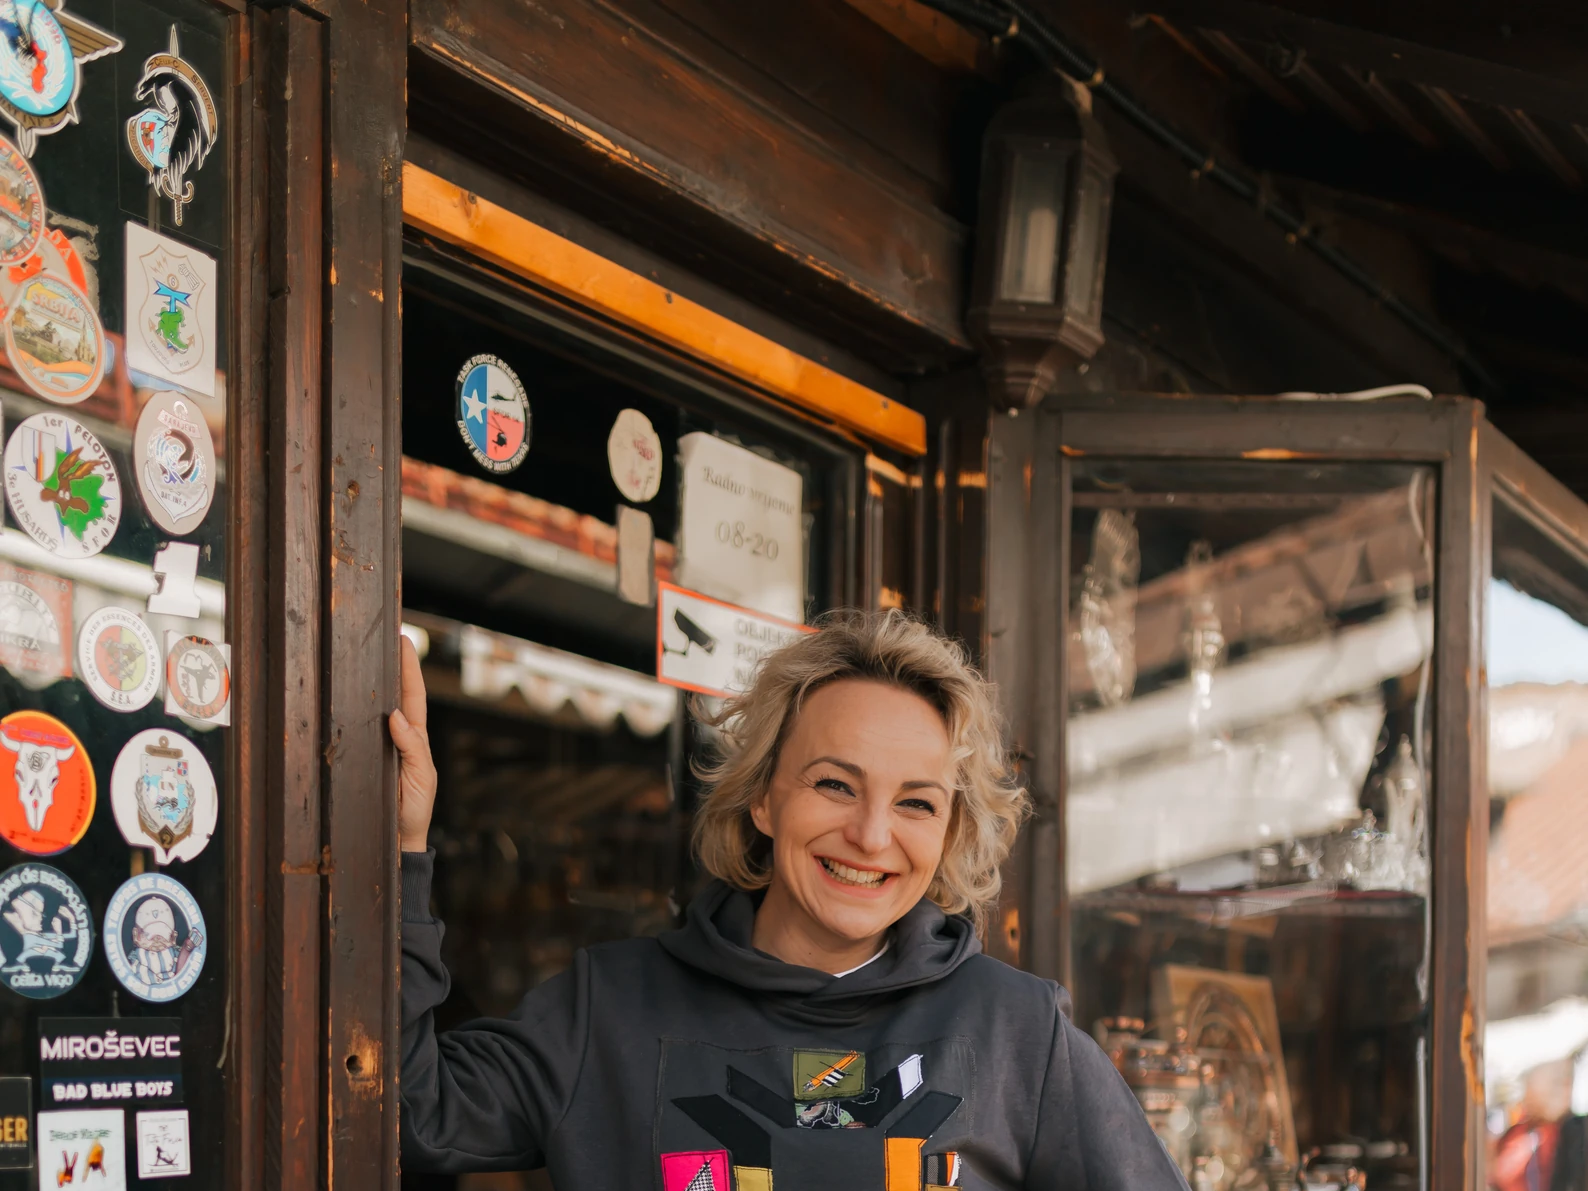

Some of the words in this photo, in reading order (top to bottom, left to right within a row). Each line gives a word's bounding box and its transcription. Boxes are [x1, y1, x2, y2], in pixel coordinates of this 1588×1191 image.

[31, 290, 82, 324] SRBIJA
[457, 360, 474, 383] TASK
[471, 353, 497, 365] FORCE
[497, 358, 530, 409] RENEGADE
[43, 416, 63, 428] 1er
[75, 424, 116, 482] PELOTON
[472, 447, 494, 471] MESS
[703, 466, 746, 496] Radno
[12, 492, 58, 551] HUSARDS
[715, 519, 779, 563] 08-20
[102, 613, 141, 632] ESSENCES
[40, 1029, 181, 1060] MIROŠEVEC
[52, 1083, 88, 1101] BAD
[90, 1082, 133, 1100] BLUE
[135, 1080, 173, 1097] BOYS
